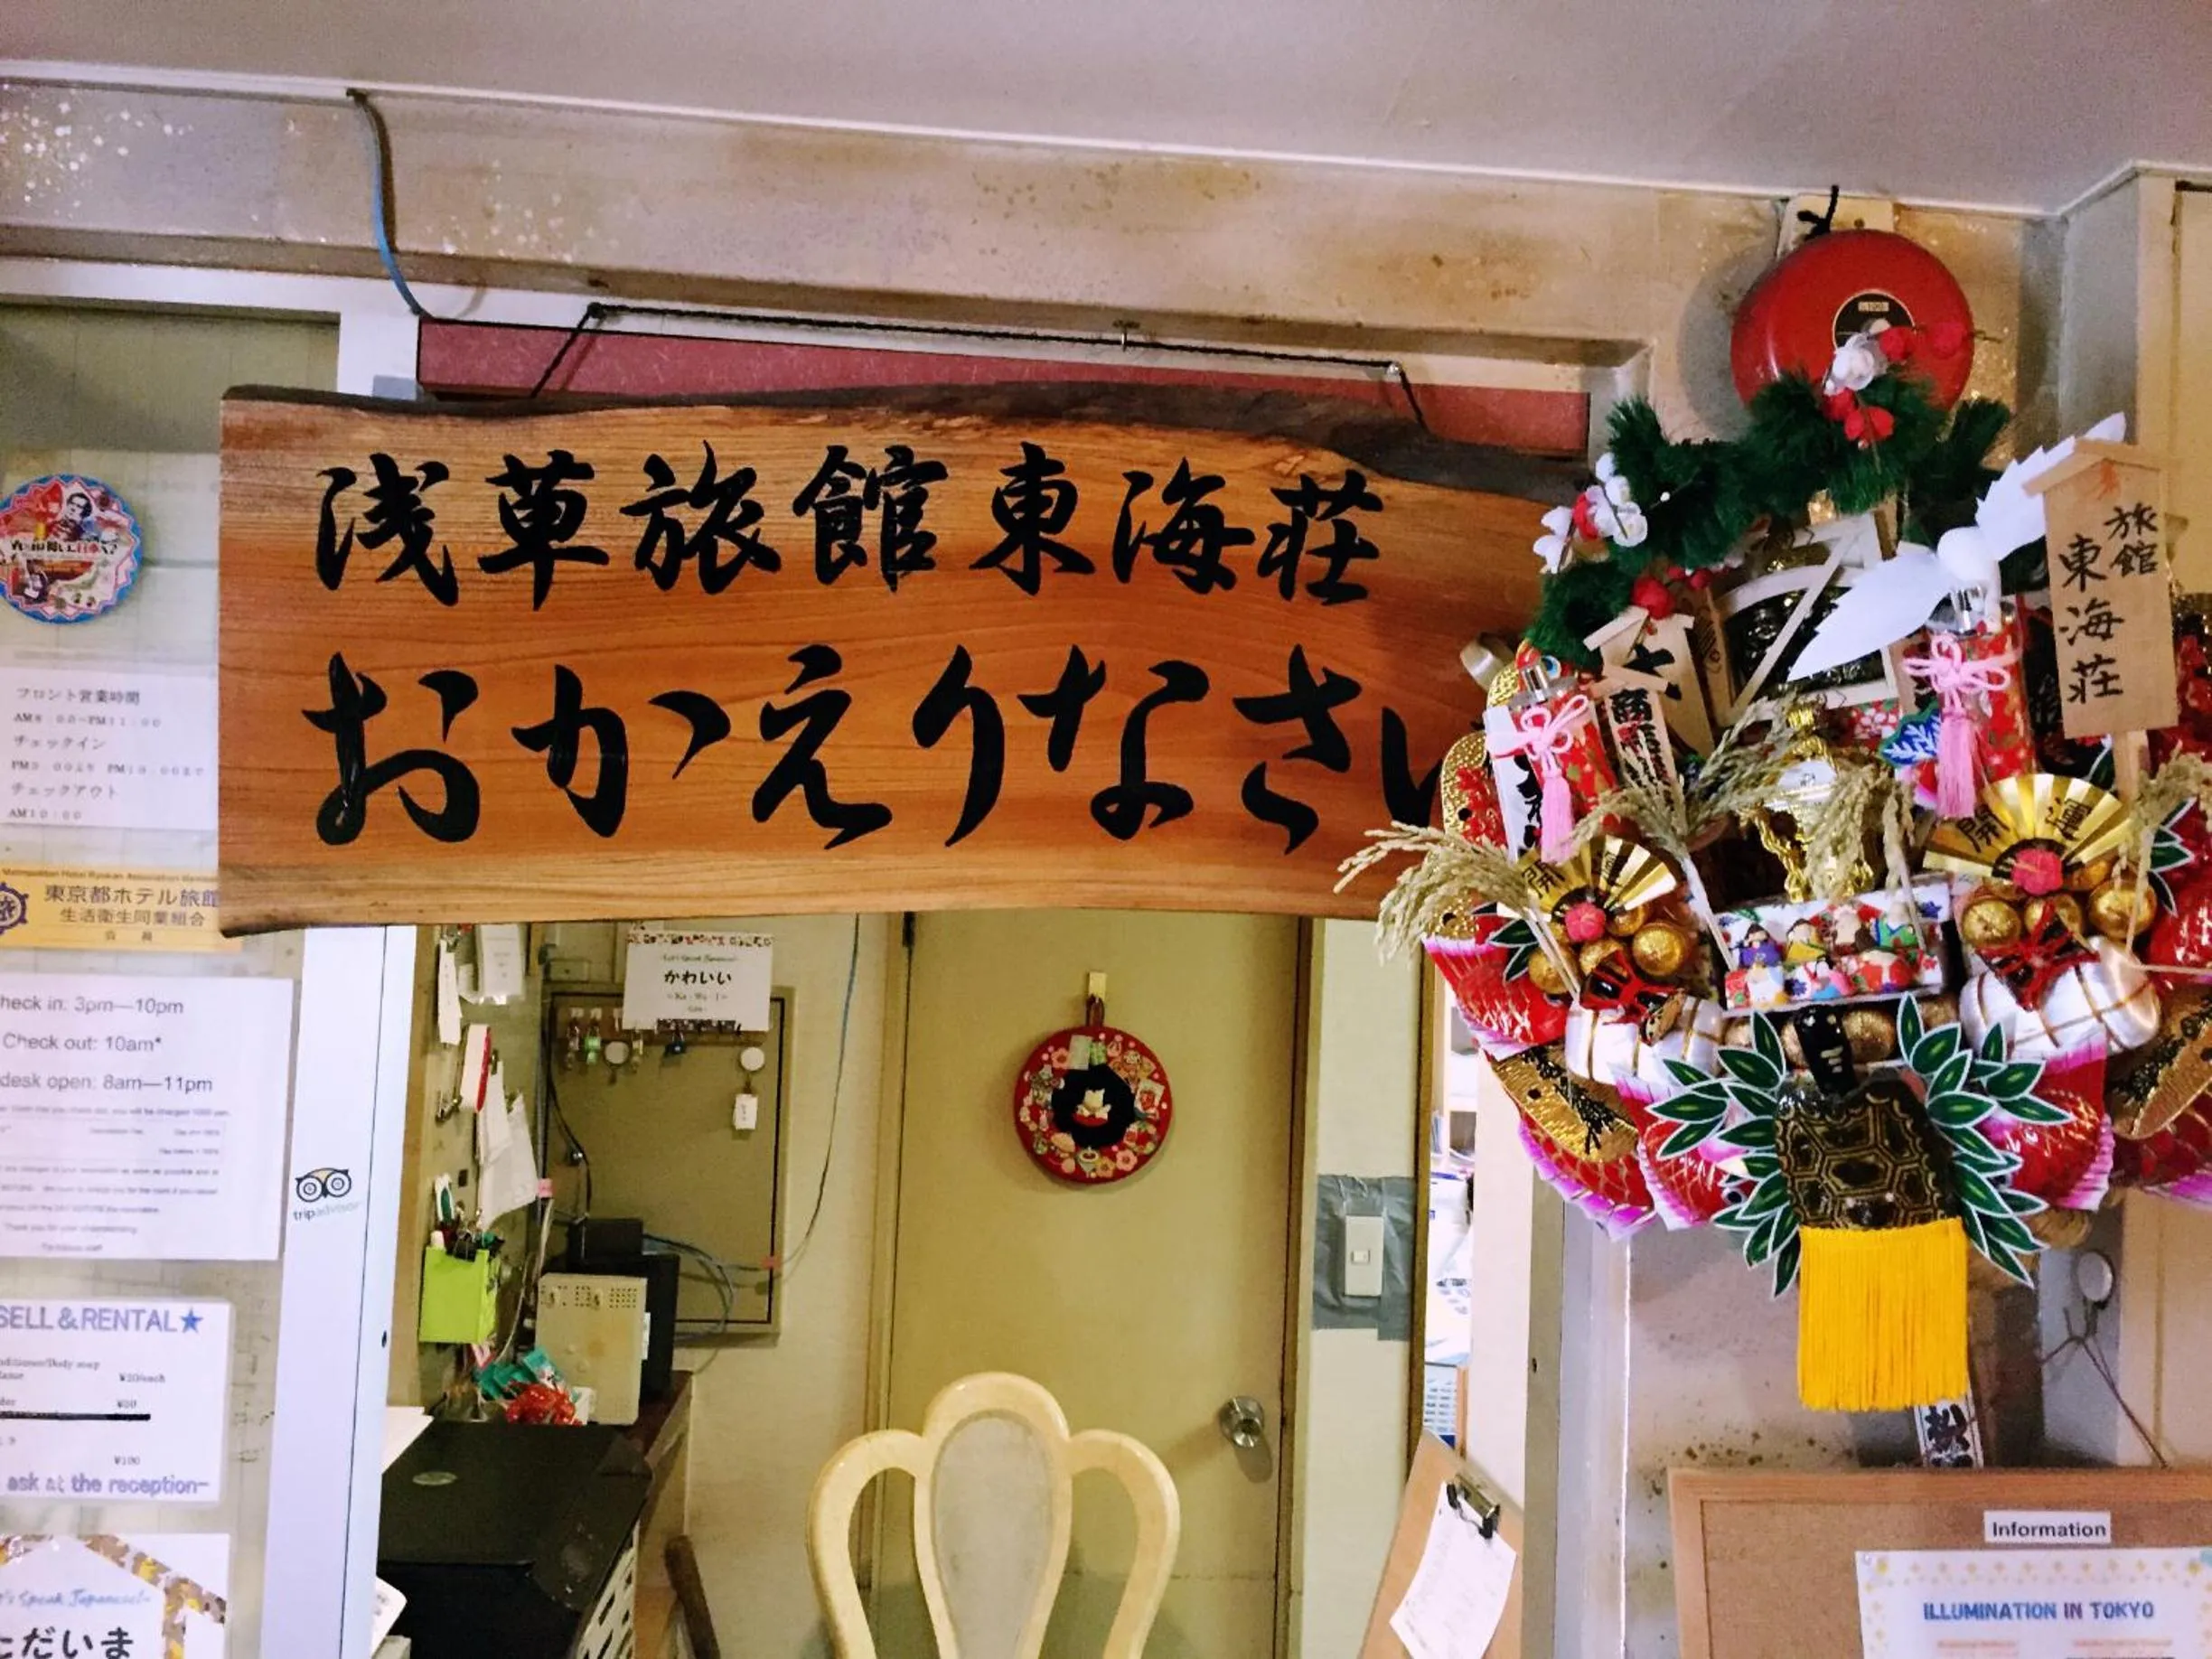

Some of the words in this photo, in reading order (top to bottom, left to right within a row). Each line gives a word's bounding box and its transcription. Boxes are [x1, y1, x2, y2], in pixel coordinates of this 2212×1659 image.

[316, 440, 1383, 612] 浅草旅館東海荘
[2104, 501, 2160, 577] 旅館
[2057, 534, 2125, 705] 東海荘
[664, 969, 732, 985] かわいい
[3, 1033, 58, 1051] Check
[0, 1071, 42, 1089] desk
[47, 1075, 96, 1092] open:
[7, 1472, 40, 1492] ask
[71, 1473, 103, 1493] the
[1992, 1521, 2107, 1538] Information
[1923, 1601, 2057, 1621] ILLUMINATION
[2064, 1601, 2084, 1620] IN
[2091, 1600, 2155, 1621] TOKYO
